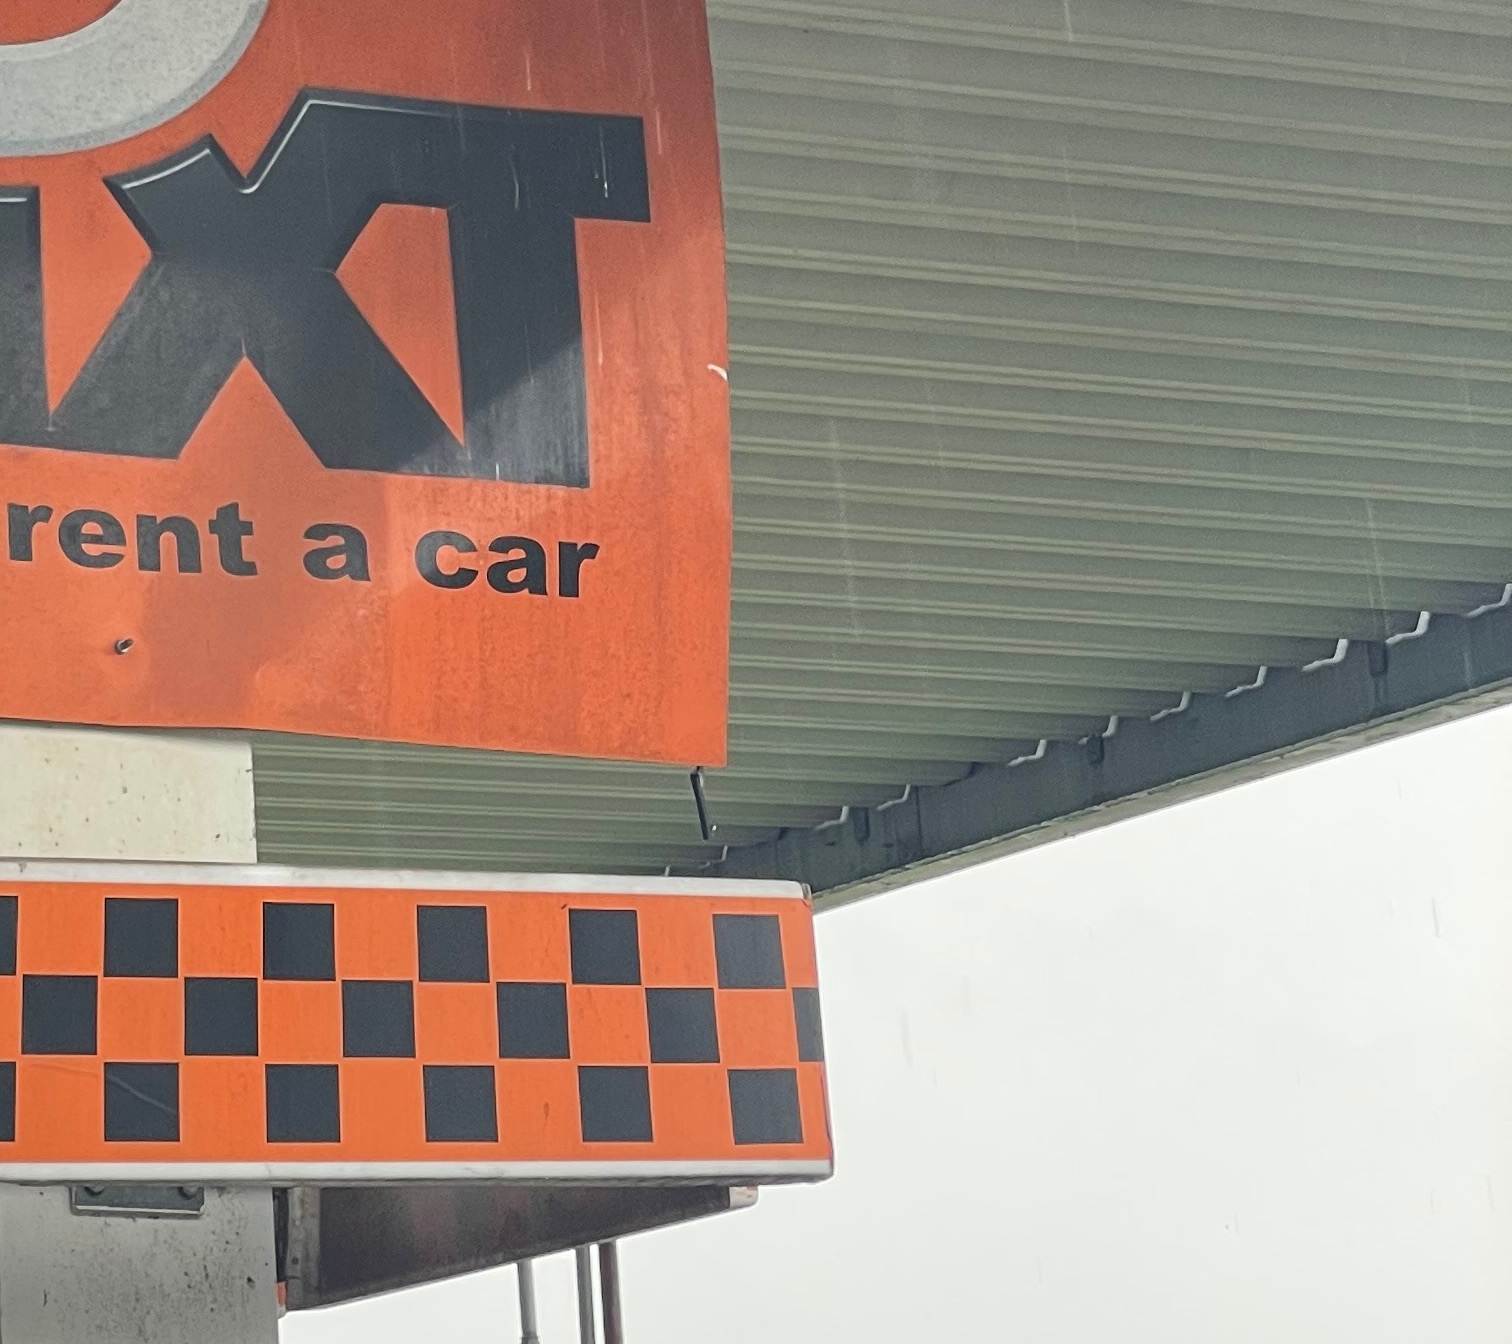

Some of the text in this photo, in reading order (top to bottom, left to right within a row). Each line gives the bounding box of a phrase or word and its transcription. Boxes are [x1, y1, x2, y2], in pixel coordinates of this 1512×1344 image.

[6, 501, 601, 598] rent a car
